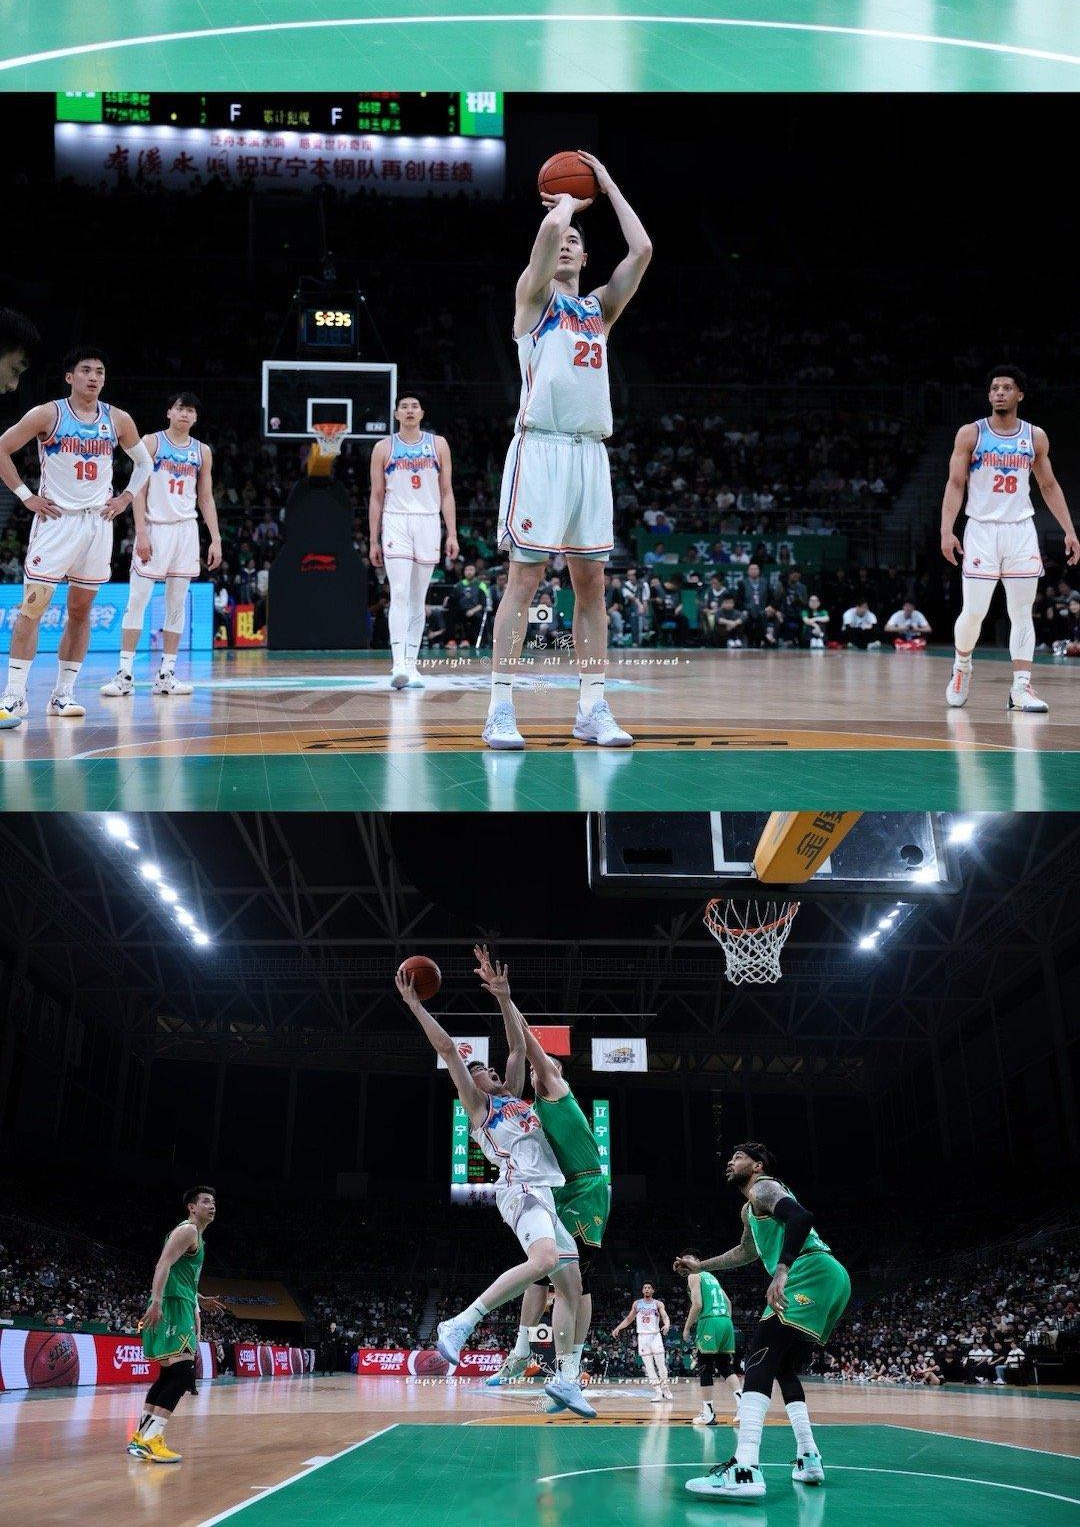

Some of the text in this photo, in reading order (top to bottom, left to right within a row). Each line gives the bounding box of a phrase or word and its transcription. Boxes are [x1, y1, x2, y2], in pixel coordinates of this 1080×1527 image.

[230, 104, 242, 121] F
[331, 108, 343, 125] F
[573, 341, 602, 369] 23
[74, 461, 98, 481] 19
[168, 480, 184, 495] 11
[411, 475, 421, 489] 9
[993, 474, 1017, 494] 28
